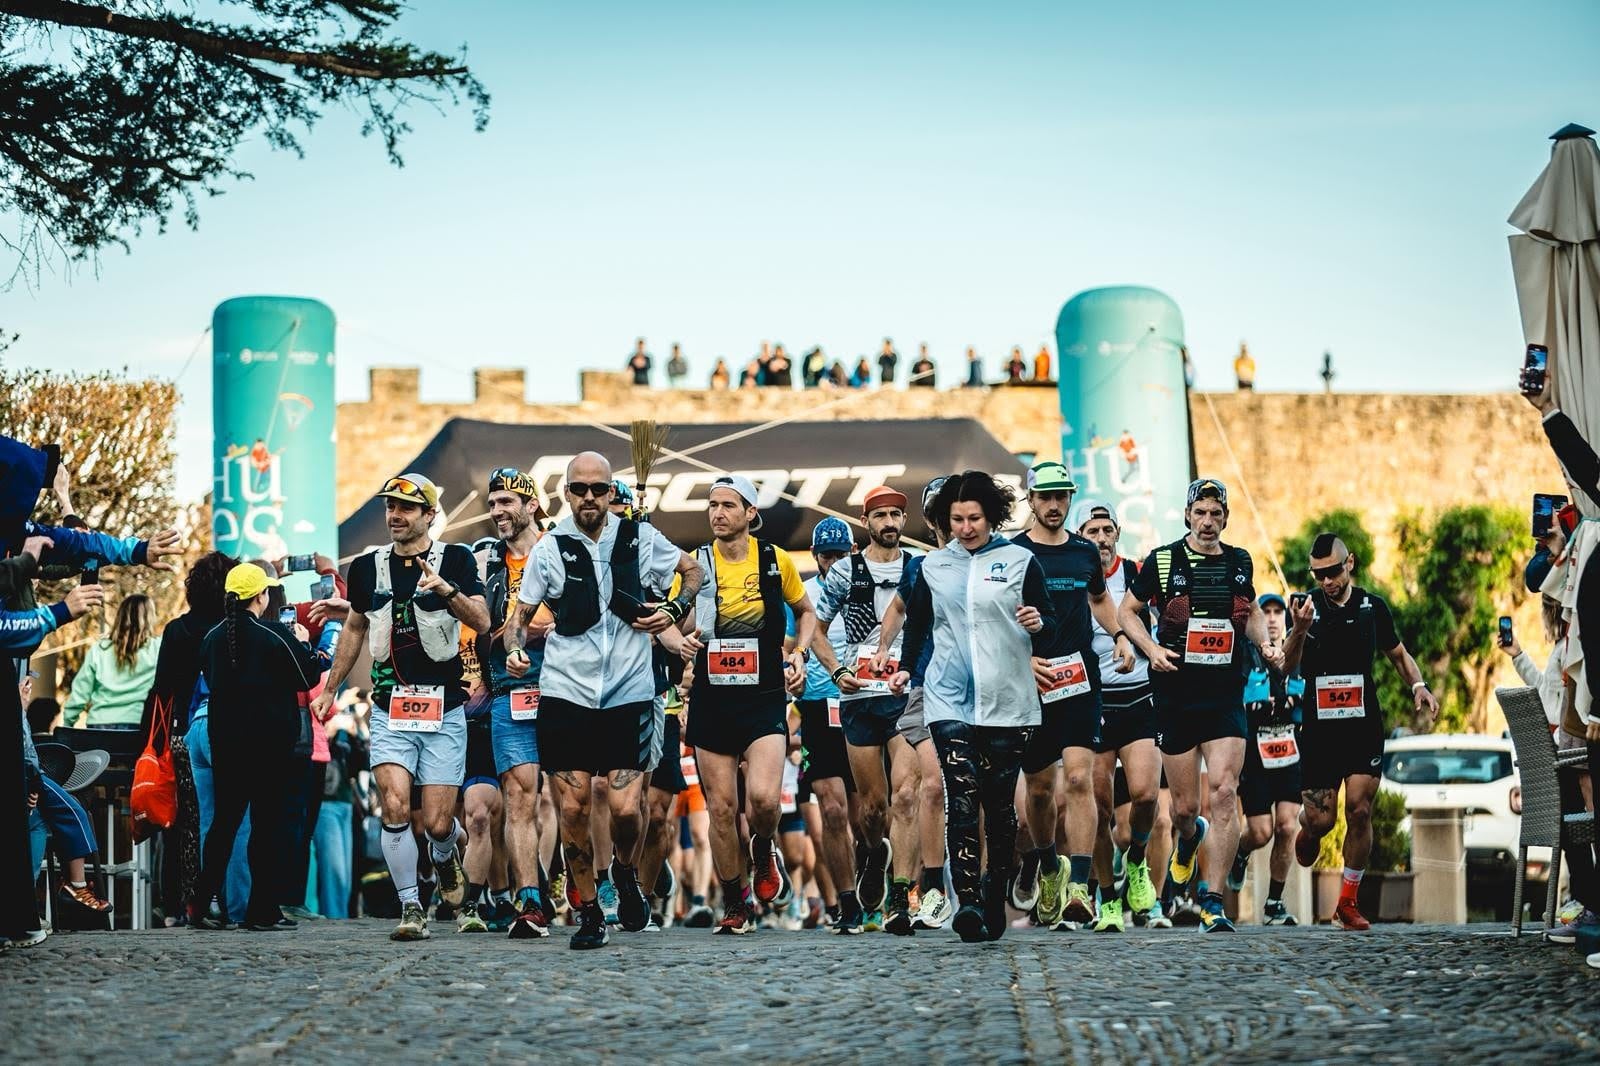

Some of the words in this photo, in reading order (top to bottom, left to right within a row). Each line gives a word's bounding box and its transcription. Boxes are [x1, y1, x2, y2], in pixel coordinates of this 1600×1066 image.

[610, 464, 907, 514] SCOTT
[1200, 636, 1224, 648] 496
[720, 656, 746, 668] 484
[1055, 669, 1074, 682] 80
[524, 694, 541, 705] 23
[1329, 692, 1352, 702] 547
[402, 701, 430, 713] 507
